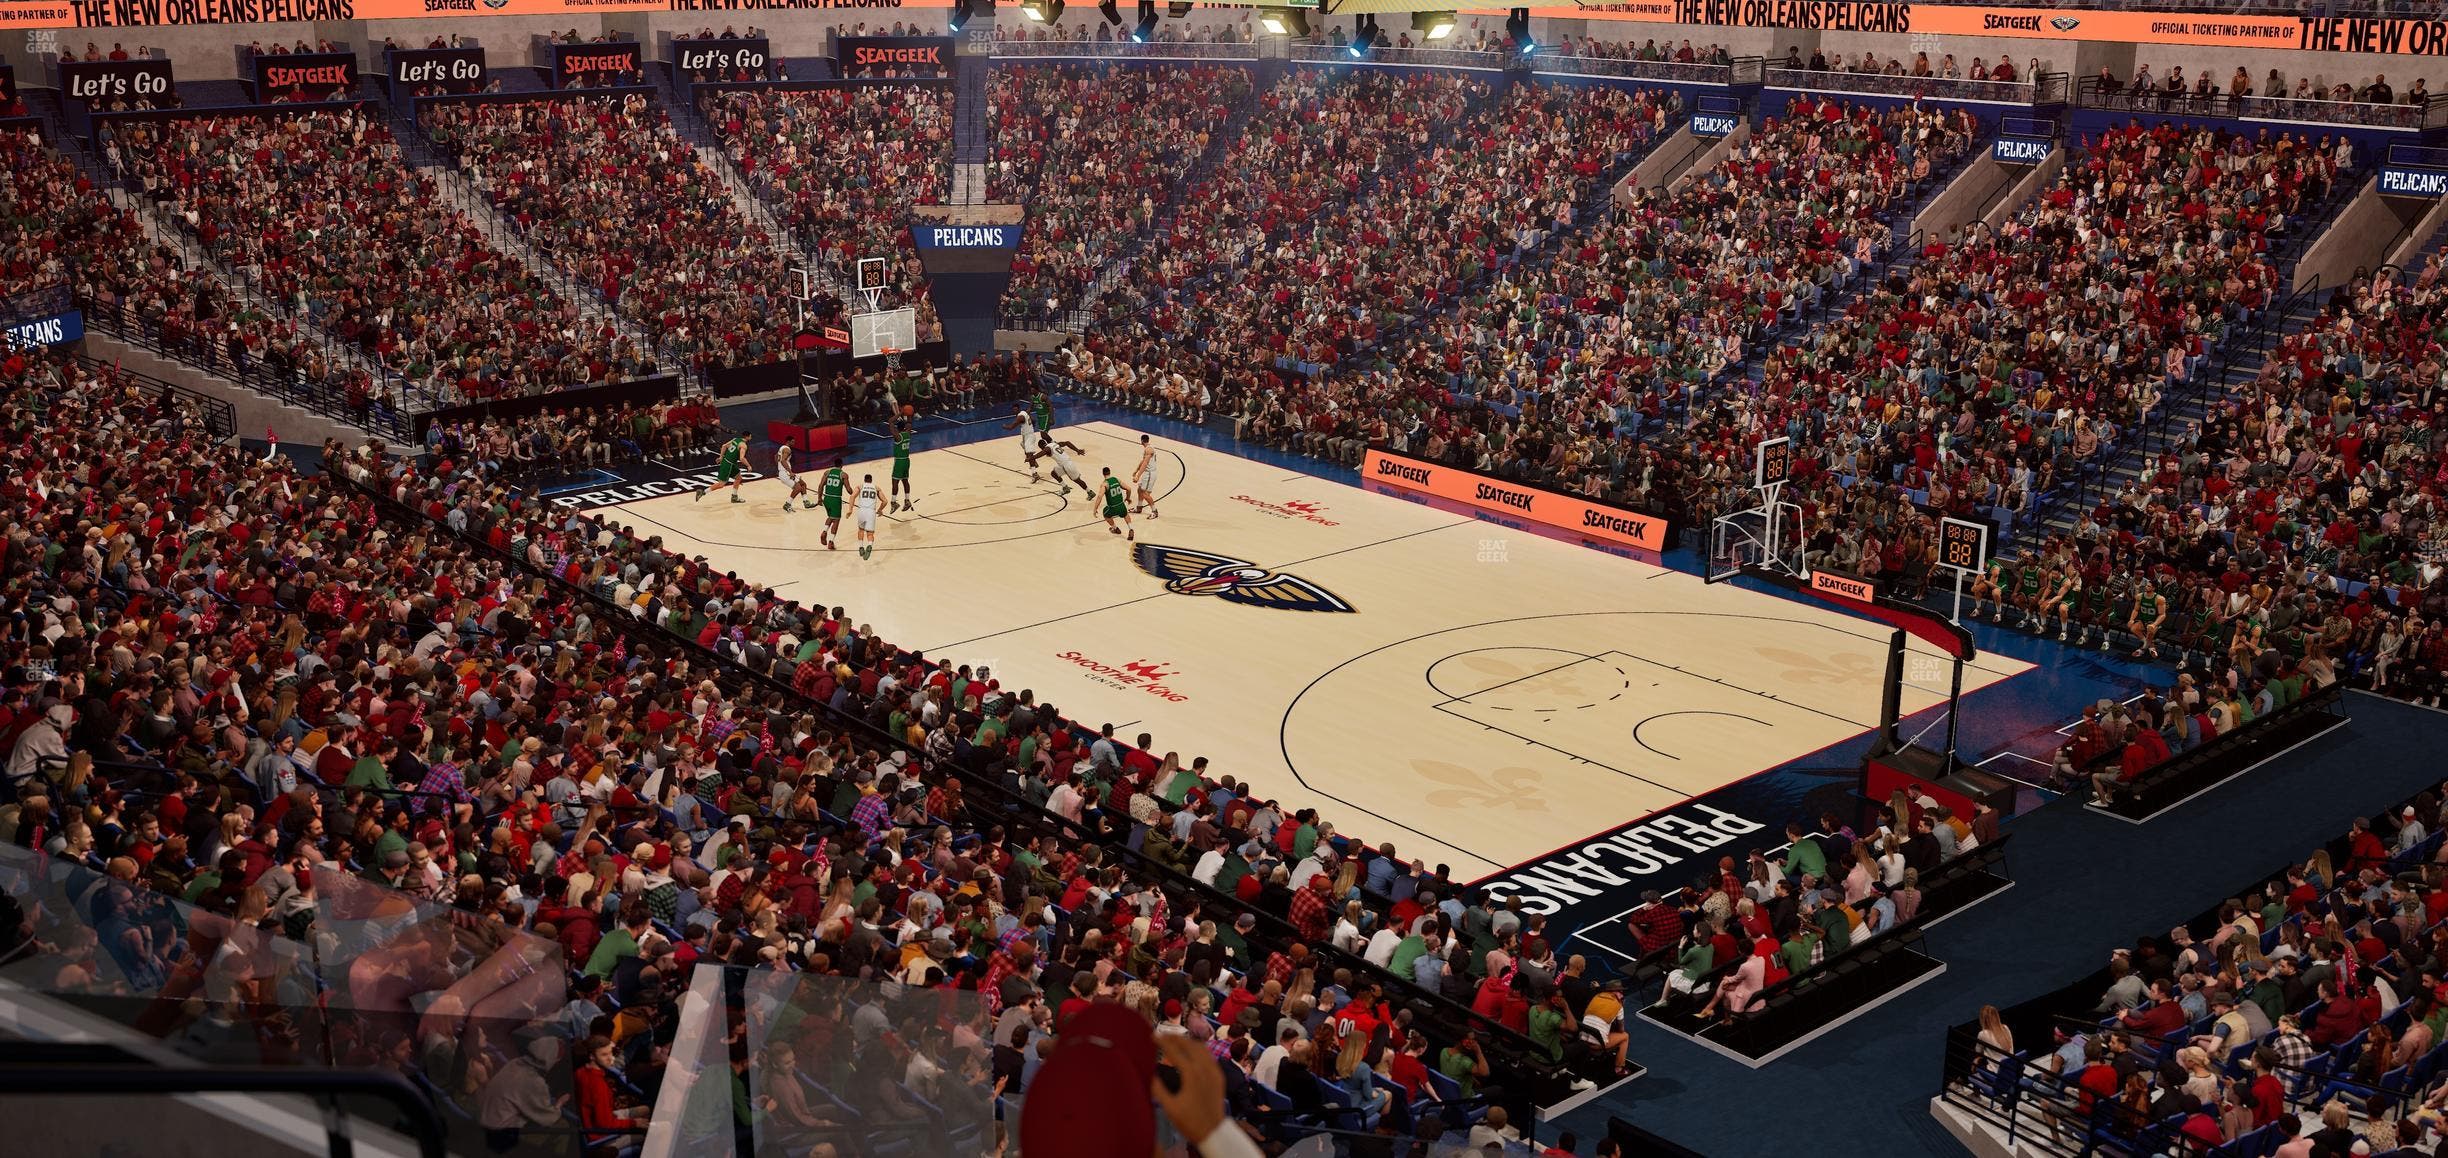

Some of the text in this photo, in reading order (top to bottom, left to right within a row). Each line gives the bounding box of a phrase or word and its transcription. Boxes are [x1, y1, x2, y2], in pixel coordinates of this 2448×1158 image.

[18, 10, 55, 20] PARTNER
[57, 9, 68, 19] OF
[70, 1, 110, 27] THE
[115, 0, 160, 26] NEW
[166, 0, 258, 25] ORLEANS
[262, 0, 354, 22] PELICANS
[1636, 4, 1662, 14] PARTNER
[1664, 5, 1671, 14] OF
[1674, 0, 1701, 24] THE
[1705, 0, 1740, 25] NEW
[1744, 1, 1821, 29] ORLEANS
[1824, 3, 1909, 33] PELICANS
[1984, 14, 2042, 31] SEATGEEK
[2152, 18, 2448, 55] OFFICIAL TICKETING PARTNER OF THE NEW OR
[565, 53, 634, 74] SEATGEEK
[682, 49, 764, 69] Let's Go
[855, 46, 941, 65] SEATGEEK
[267, 64, 349, 88] SEATGEEK
[400, 59, 480, 82] Let's Go
[72, 72, 167, 97] Let's Go
[1694, 117, 1734, 133] PELICANS
[1998, 141, 2047, 160] PELICANS
[2384, 171, 2447, 194] PELICANS
[934, 228, 1003, 247] PELICANS
[1378, 459, 1431, 486] SEATGEEK
[1767, 459, 1783, 479] 88
[1476, 483, 1534, 512] SEATGEEK
[1299, 514, 1340, 526] KING
[1583, 509, 1647, 540] SEATGEEK
[1950, 541, 1971, 566] 88
[1818, 575, 1866, 598] SEATGEEK
[1056, 651, 1188, 702] SMOOTHIE KING
[1084, 673, 1127, 691] CENTER
[1480, 803, 1767, 916] PELICANS
